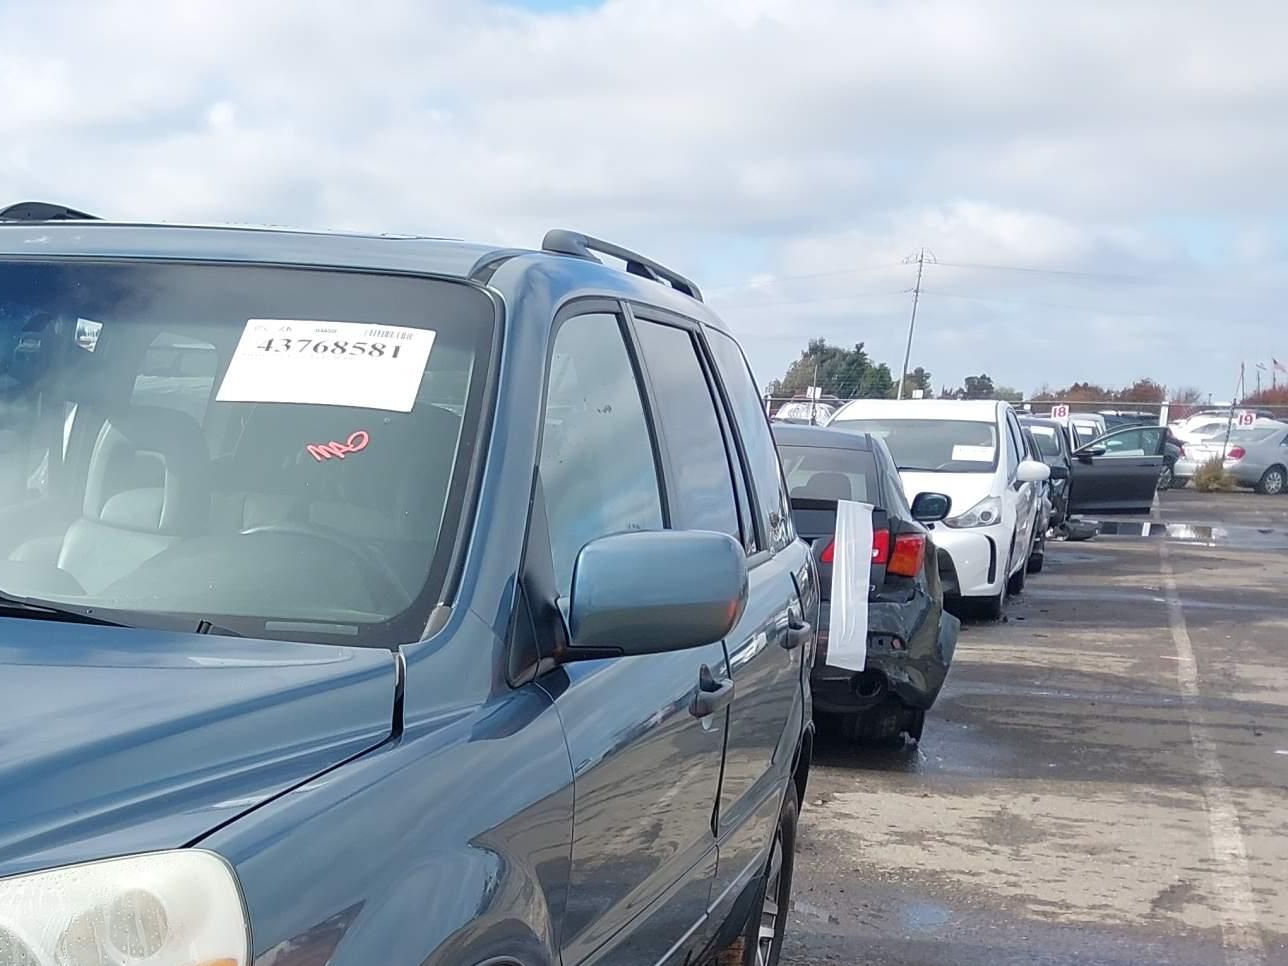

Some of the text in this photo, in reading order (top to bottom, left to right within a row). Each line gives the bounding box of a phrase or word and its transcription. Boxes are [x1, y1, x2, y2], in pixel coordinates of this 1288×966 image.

[257, 337, 401, 359] 43768581
[1052, 405, 1067, 418] 18
[1238, 414, 1254, 426] 19
